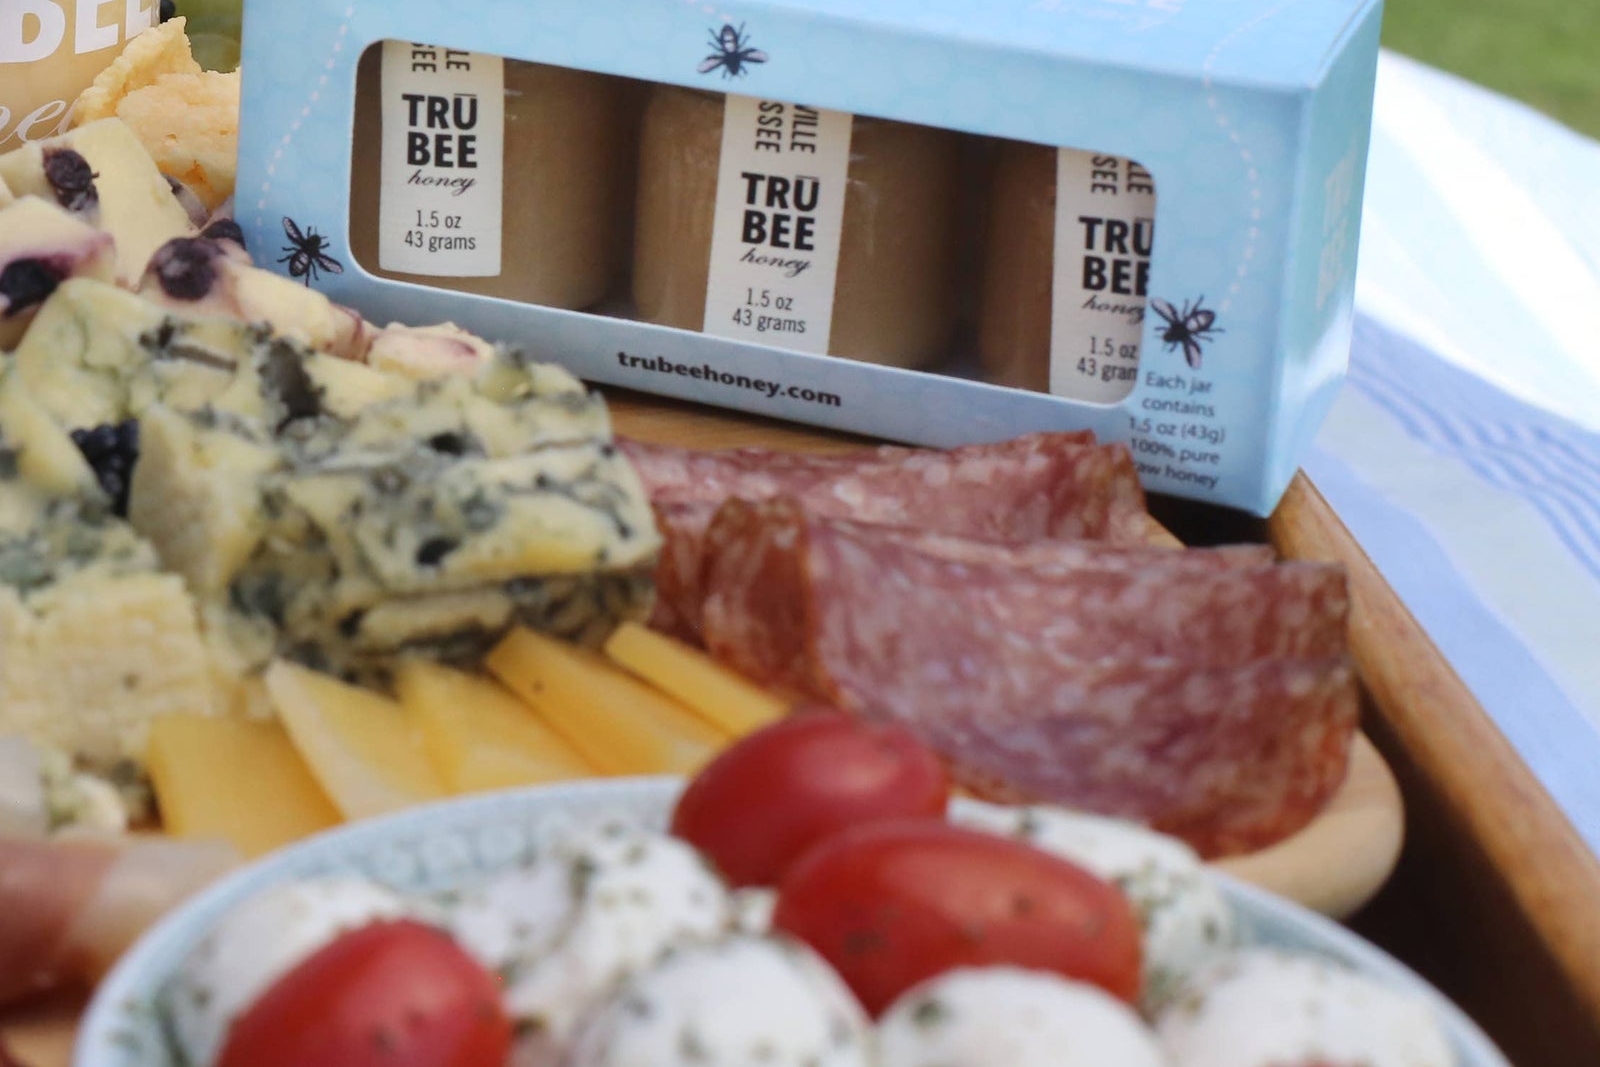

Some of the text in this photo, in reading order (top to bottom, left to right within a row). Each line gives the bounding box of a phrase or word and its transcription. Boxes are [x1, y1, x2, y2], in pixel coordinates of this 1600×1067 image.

[407, 131, 478, 169] BEE
[407, 168, 477, 196] honey
[416, 210, 462, 229] 1.5 oz
[742, 210, 816, 251] BEE
[404, 230, 476, 253] 43 grams
[739, 248, 812, 278] honey
[1082, 255, 1151, 298] BEE
[747, 288, 793, 311] 1.5 oz
[1081, 295, 1147, 325] honey
[732, 309, 806, 334] 43 grams
[1090, 336, 1138, 359] 1.5 oz
[618, 350, 842, 408] trubeehoney.com
[1076, 357, 1138, 382] 43 gram
[1145, 371, 1212, 395] Each jar
[1142, 398, 1215, 417] contains
[1130, 416, 1225, 445] 1.5 oz (43g)
[1131, 438, 1220, 465] 100% pure
[1165, 464, 1219, 490] honey
